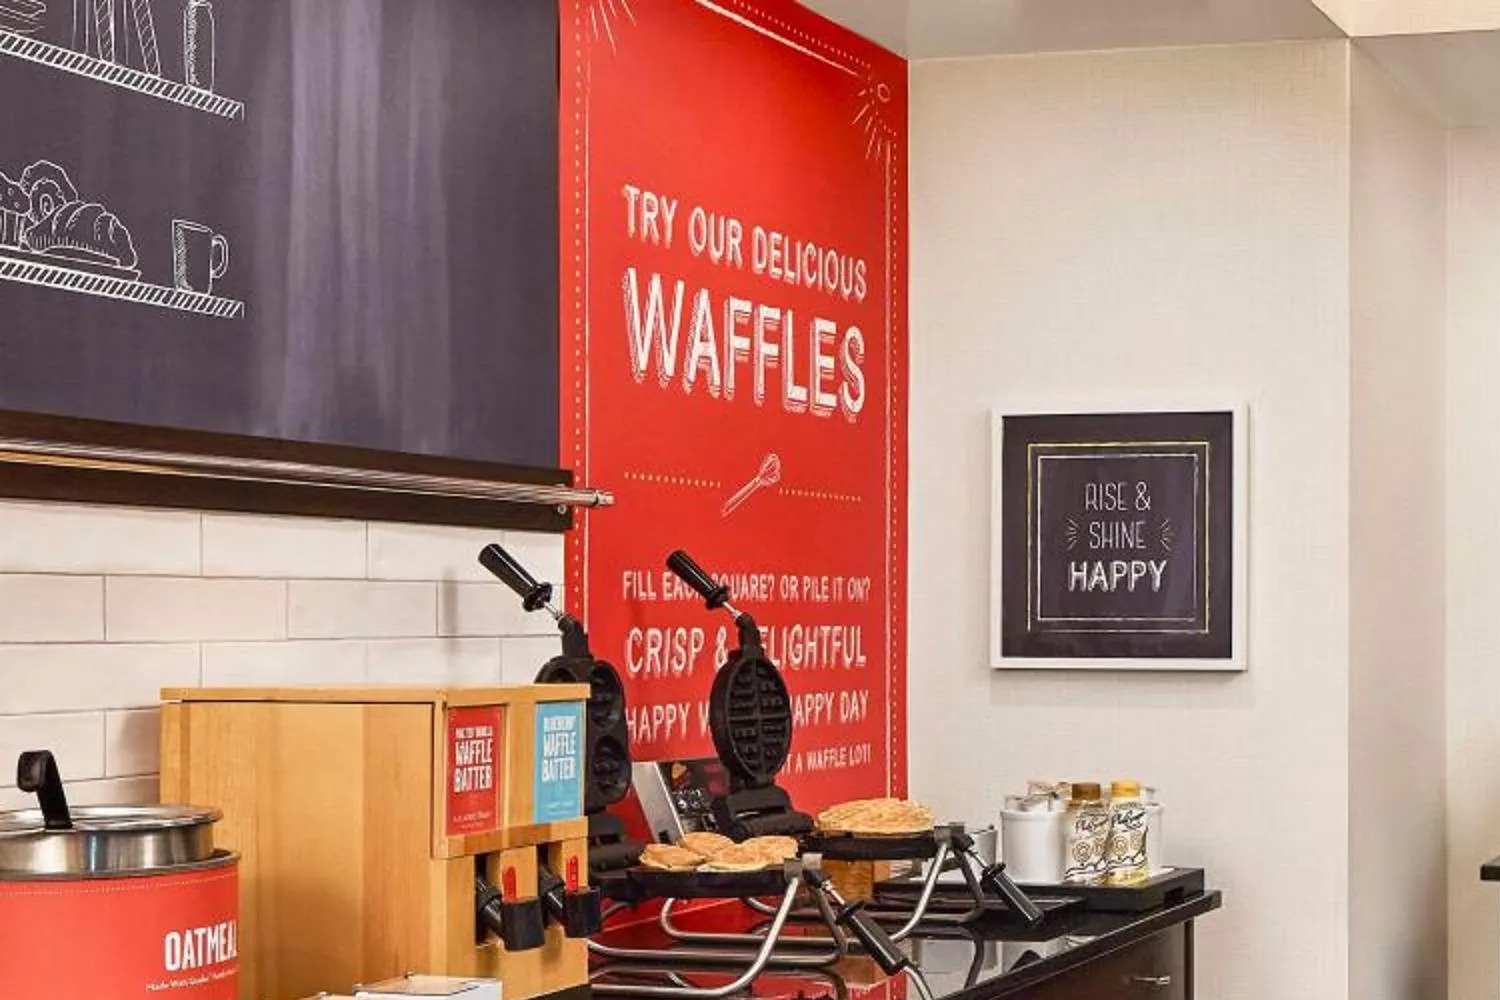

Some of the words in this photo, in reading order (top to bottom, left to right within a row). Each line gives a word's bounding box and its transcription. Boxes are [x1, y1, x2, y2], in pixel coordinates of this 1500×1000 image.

[623, 184, 677, 248] TRY
[688, 206, 743, 268] OUR
[752, 226, 867, 303] DELICIOUS
[622, 266, 866, 423] WAFFLES
[1085, 482, 1127, 511] RISE
[1135, 481, 1151, 511] &
[1089, 521, 1147, 549] SHINE
[623, 570, 656, 600] FILL
[780, 574, 799, 601] OR
[803, 575, 829, 602] PILE
[832, 576, 843, 602] IT
[847, 576, 871, 601] ON?
[1068, 560, 1167, 592] HAPPY
[625, 626, 704, 676] CRISP
[715, 625, 728, 671] &
[626, 703, 689, 741] HAPPY
[790, 692, 834, 728] APPY
[840, 690, 869, 722] DAY
[455, 738, 493, 766] WAFFLE
[543, 731, 577, 757] WAFFLE
[795, 752, 803, 773] A
[806, 747, 847, 772] WAFFLE
[453, 765, 493, 793] BATTER
